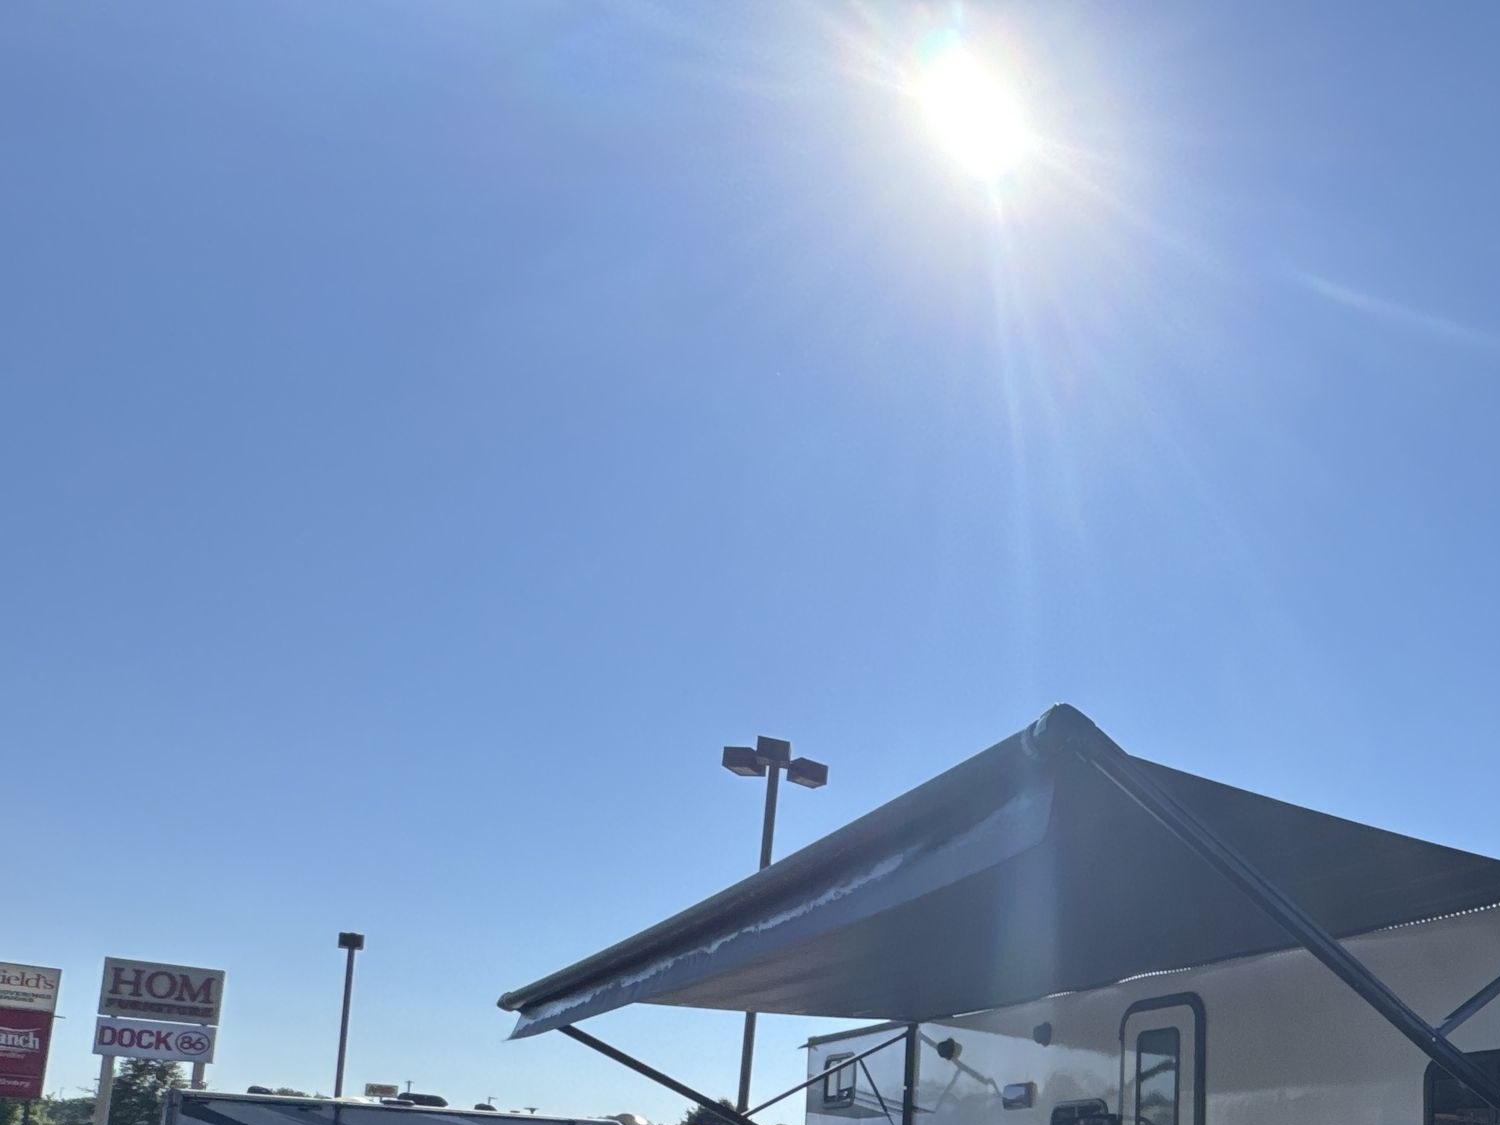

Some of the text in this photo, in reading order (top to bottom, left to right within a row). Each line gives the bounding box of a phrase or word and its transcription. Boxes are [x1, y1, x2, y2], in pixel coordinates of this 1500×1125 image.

[108, 966, 216, 1005] HOM
[98, 1025, 206, 1051] DOCK 86
